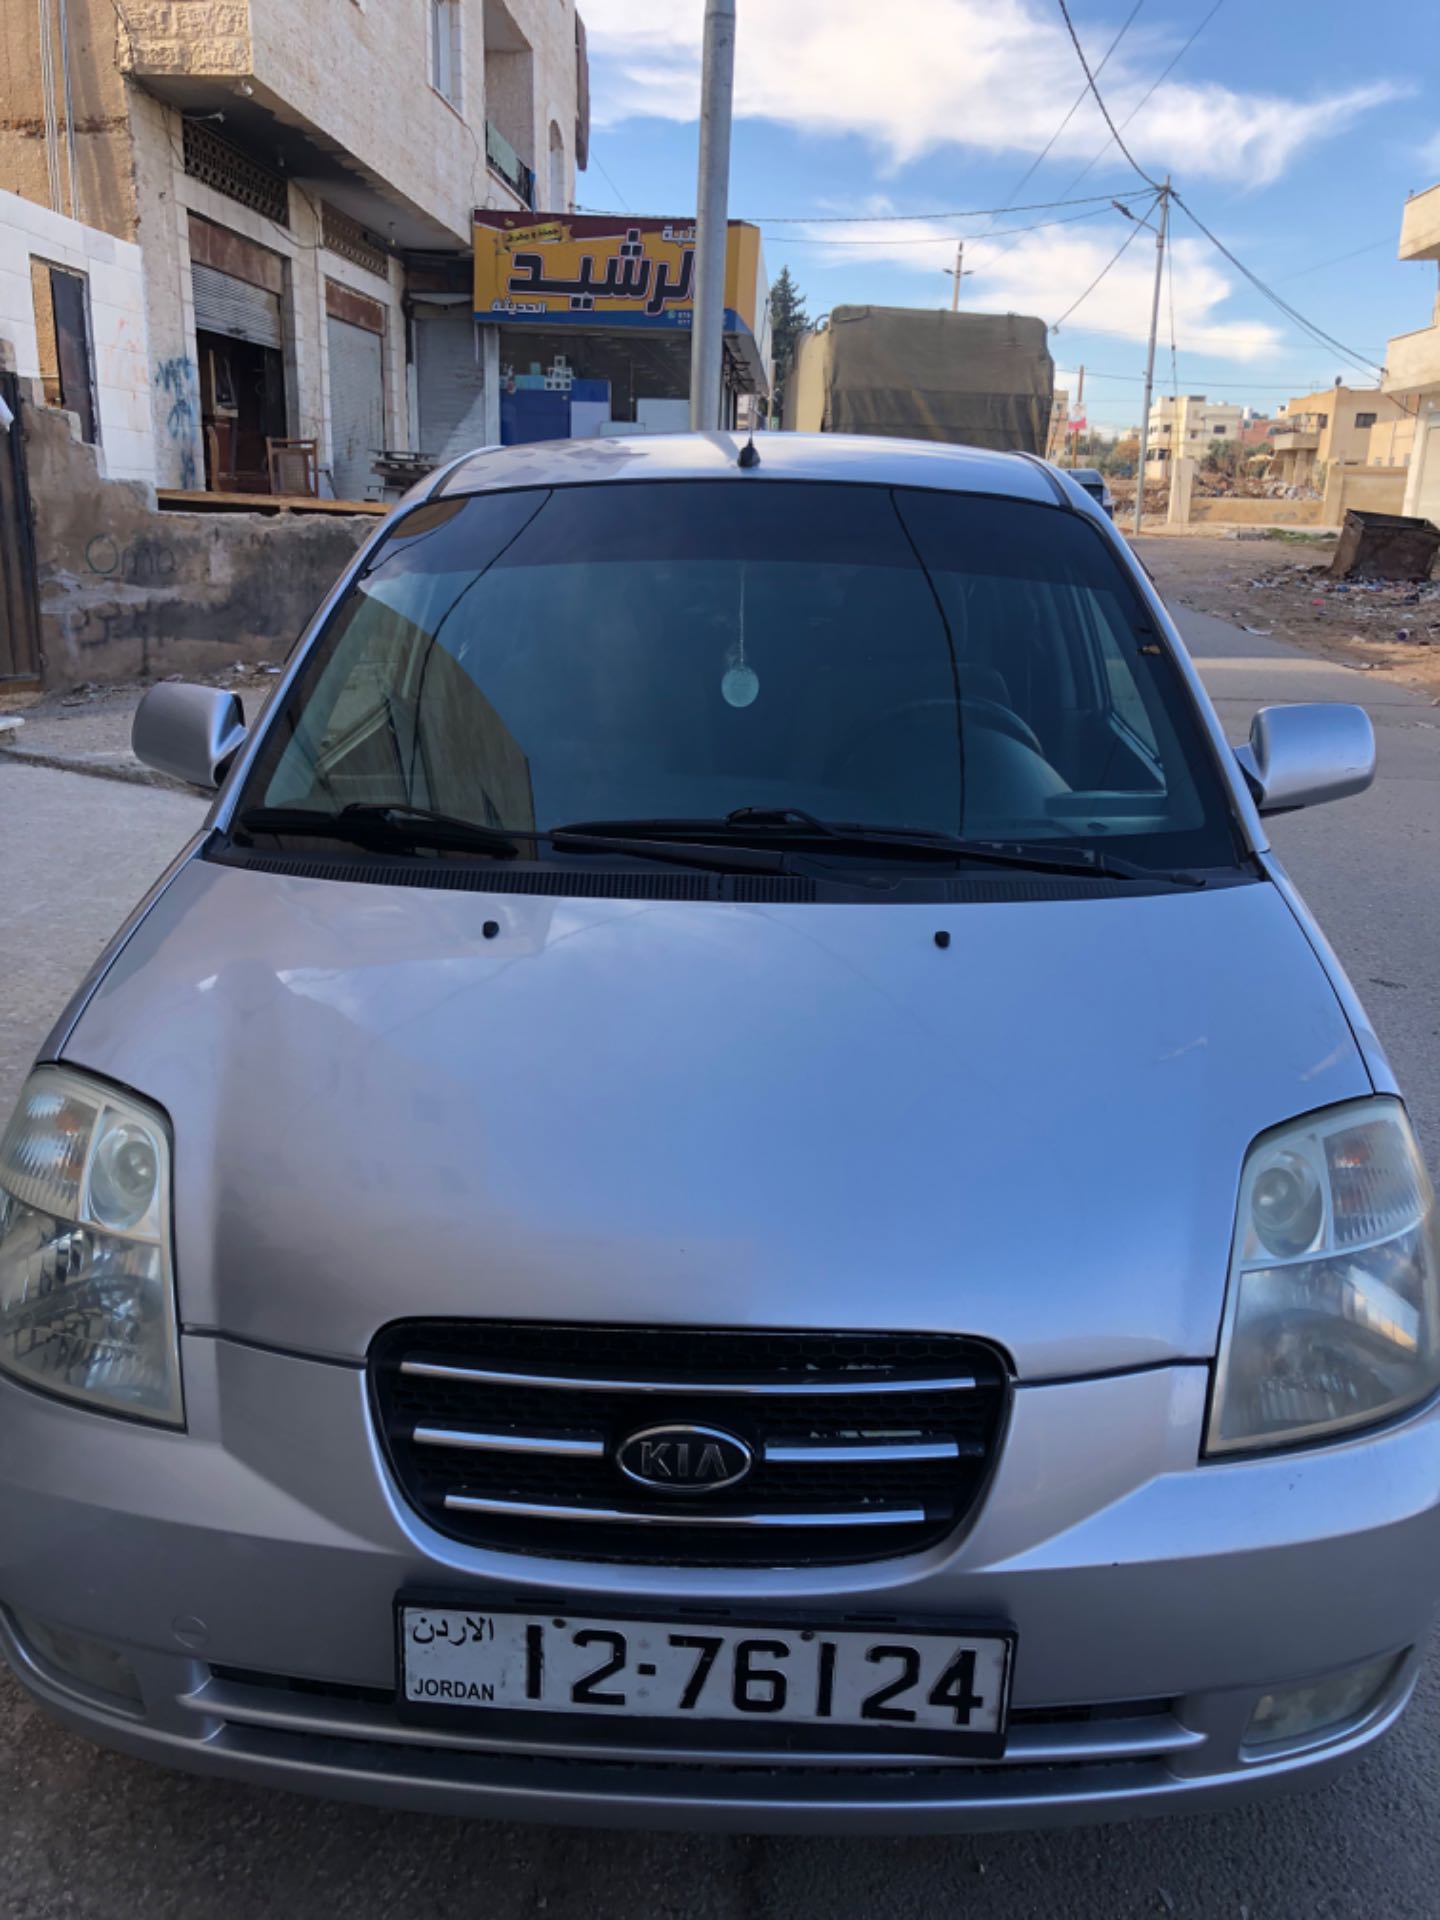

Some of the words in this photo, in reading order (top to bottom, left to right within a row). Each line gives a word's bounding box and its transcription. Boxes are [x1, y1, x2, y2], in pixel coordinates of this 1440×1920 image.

[509, 229, 696, 314] لرشيد
[641, 1441, 728, 1478] KIA
[413, 1617, 494, 1646] الاردن
[414, 1678, 494, 1700] JORDAN
[526, 1624, 983, 1725] 12-76124
